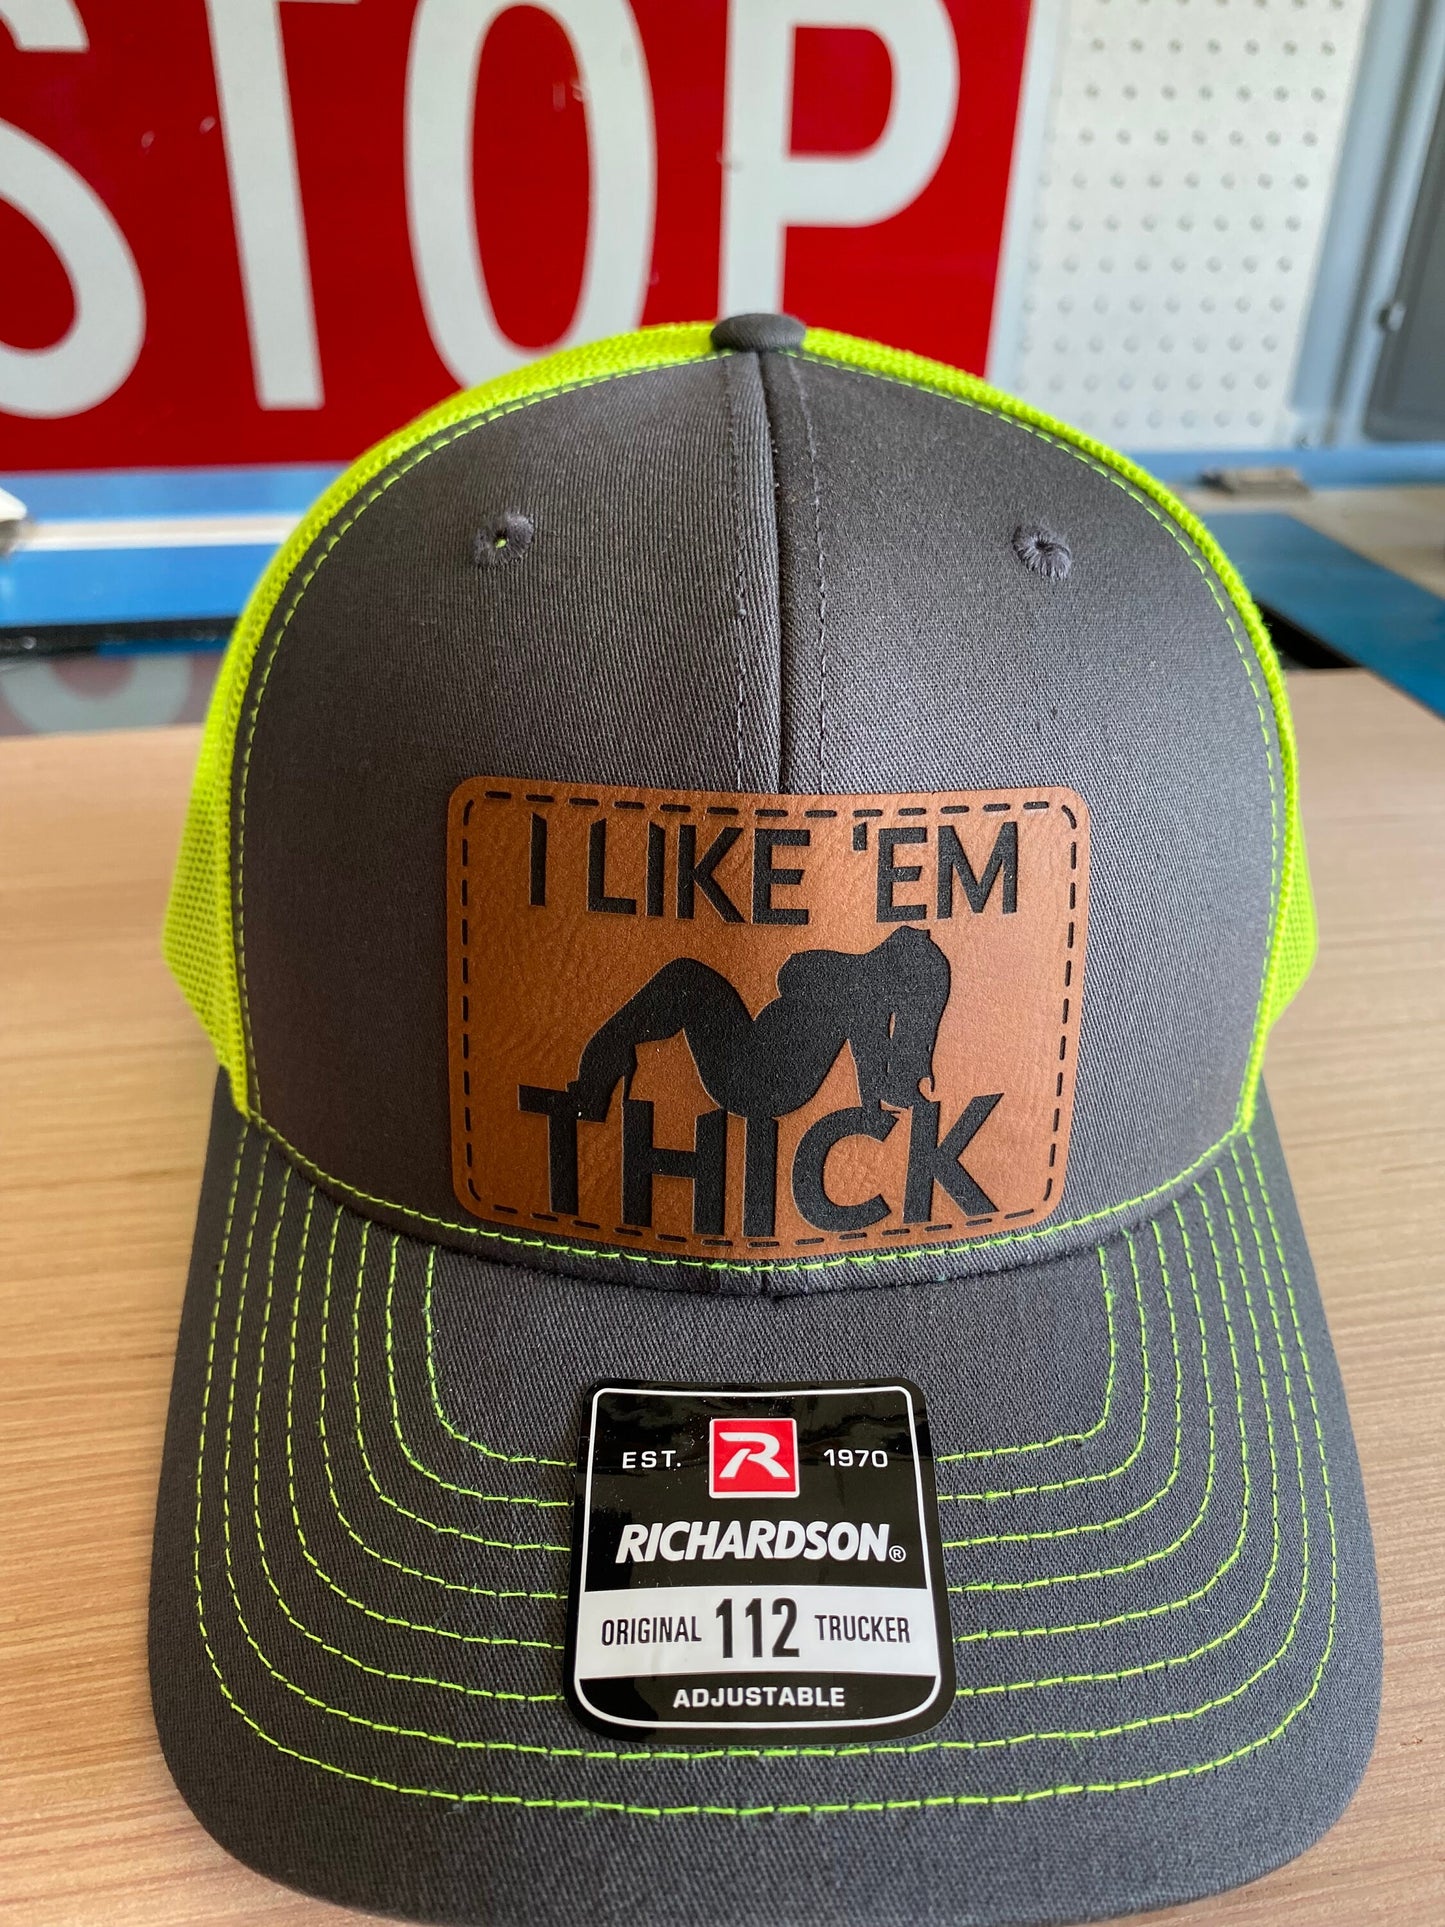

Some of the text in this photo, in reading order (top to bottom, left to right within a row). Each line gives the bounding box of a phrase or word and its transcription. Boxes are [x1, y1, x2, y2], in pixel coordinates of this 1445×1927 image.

[0, 0, 960, 419] STOP
[529, 812, 547, 907] I
[587, 817, 811, 926] LIKE
[518, 1084, 1005, 1238] THICK
[621, 1448, 888, 1469] EST. 1970
[601, 1597, 911, 1659] ORIGINAL 112 TRUCKER
[672, 1686, 846, 1709] ADJUSTABLE
